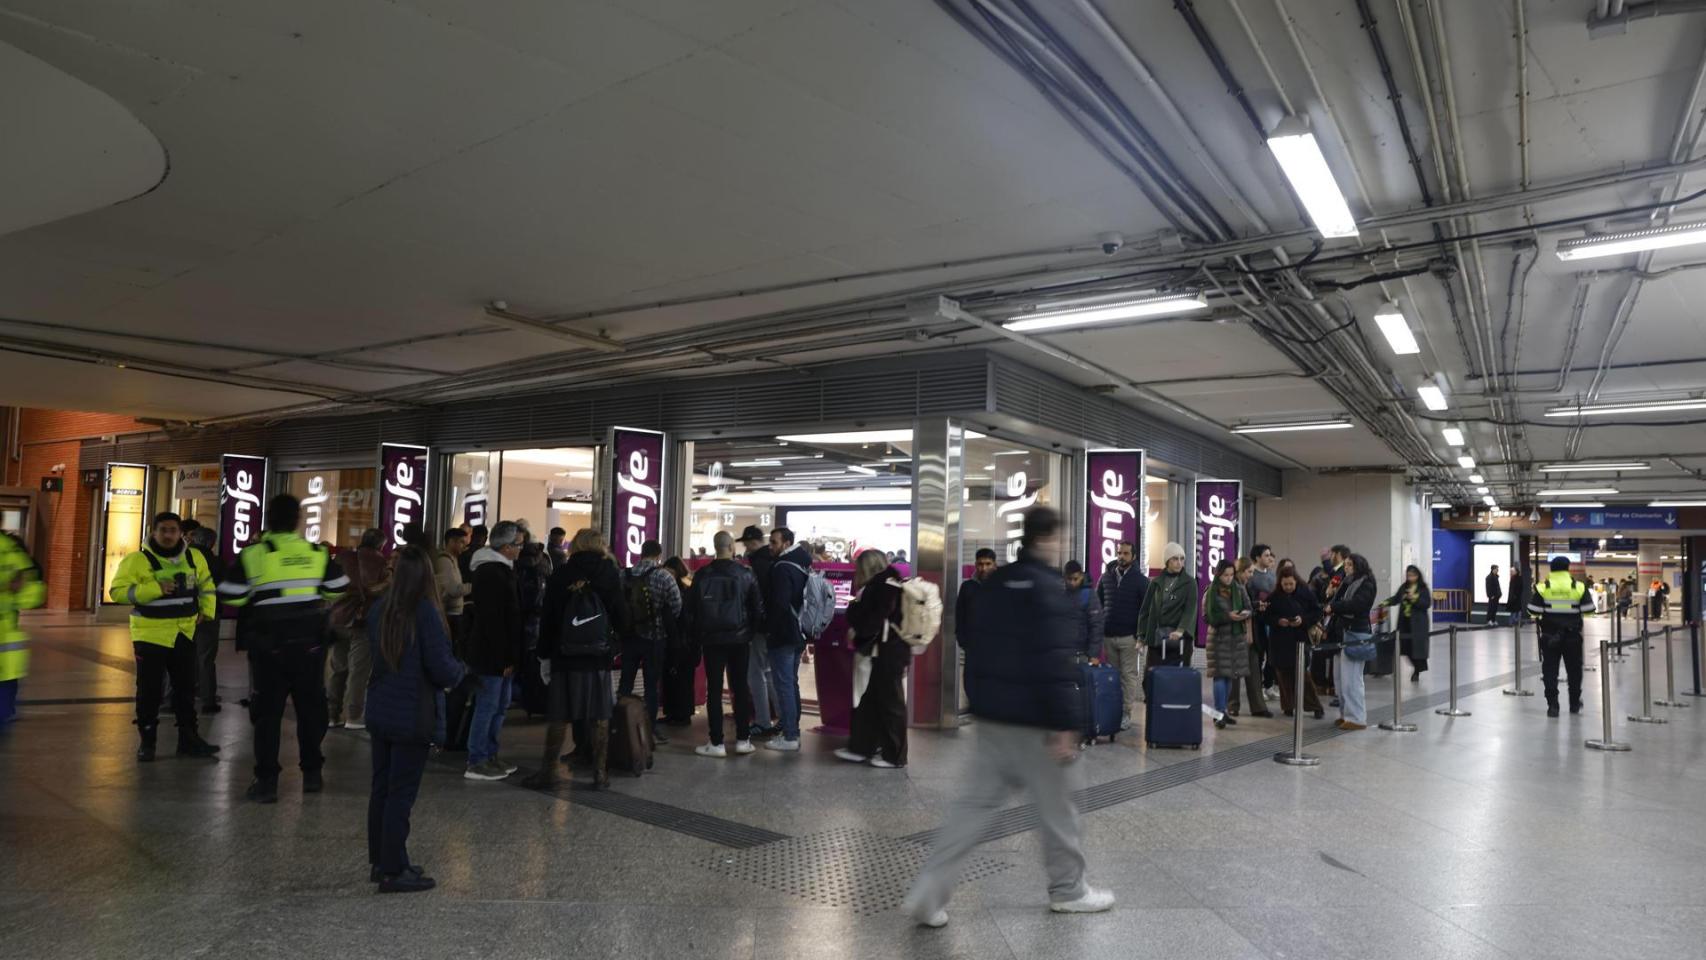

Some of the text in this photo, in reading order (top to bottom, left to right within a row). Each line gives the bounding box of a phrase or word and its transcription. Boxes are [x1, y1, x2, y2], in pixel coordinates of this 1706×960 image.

[226, 469, 261, 555] renfe
[723, 513, 735, 526] 12
[760, 513, 771, 527] 13
